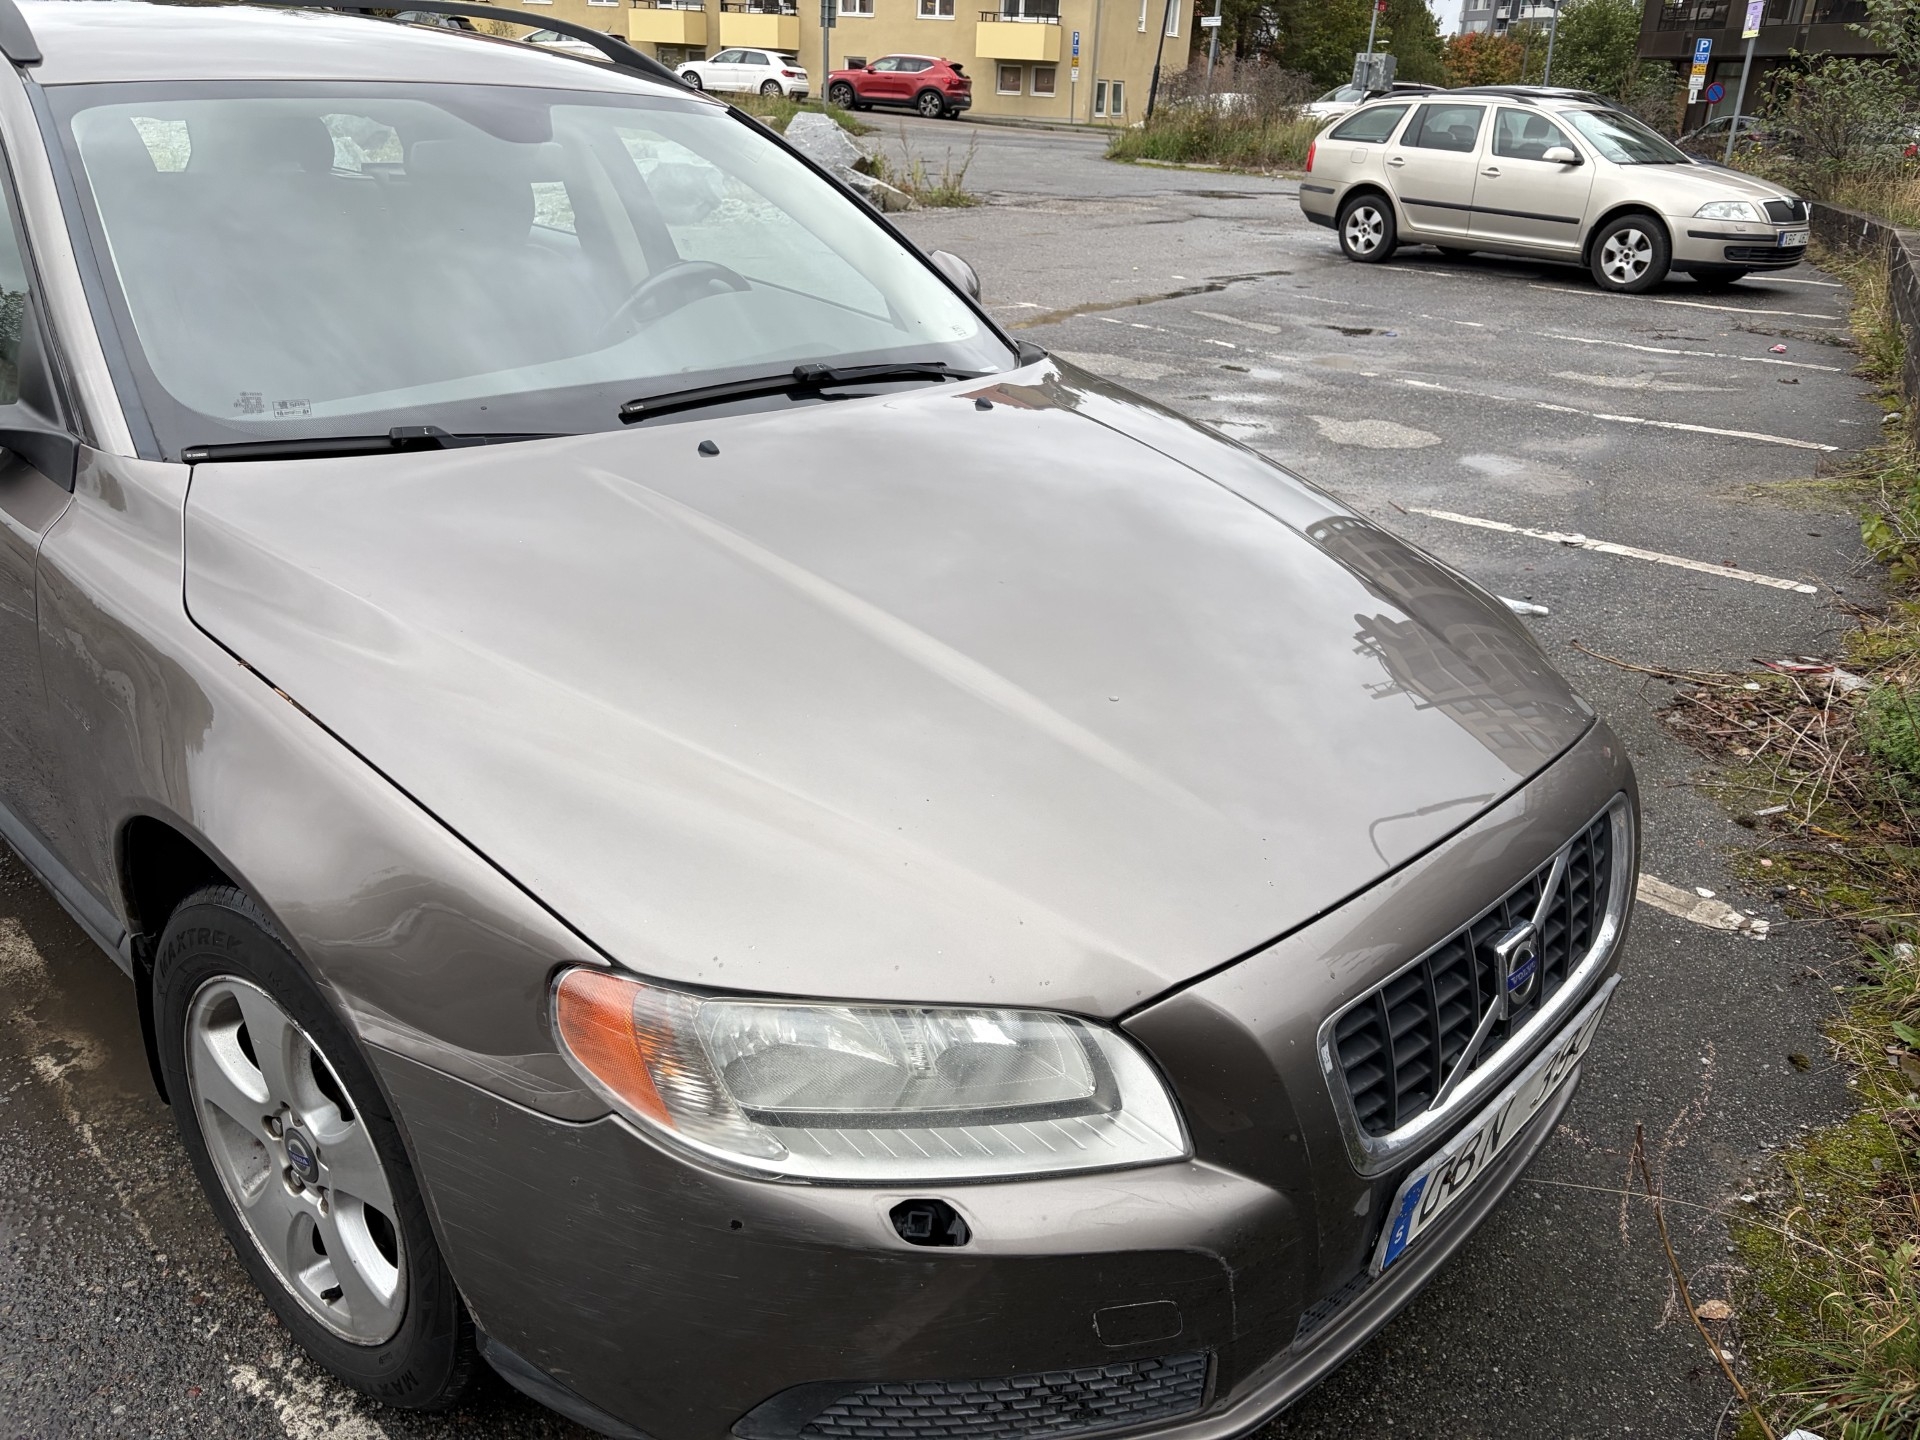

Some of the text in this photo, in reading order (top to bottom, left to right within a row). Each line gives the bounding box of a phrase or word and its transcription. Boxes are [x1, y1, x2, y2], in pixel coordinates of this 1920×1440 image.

[1699, 40, 1709, 52] P
[160, 927, 243, 979] MAXTREK
[1510, 960, 1536, 985] VOLVO
[1394, 1224, 1405, 1245] S
